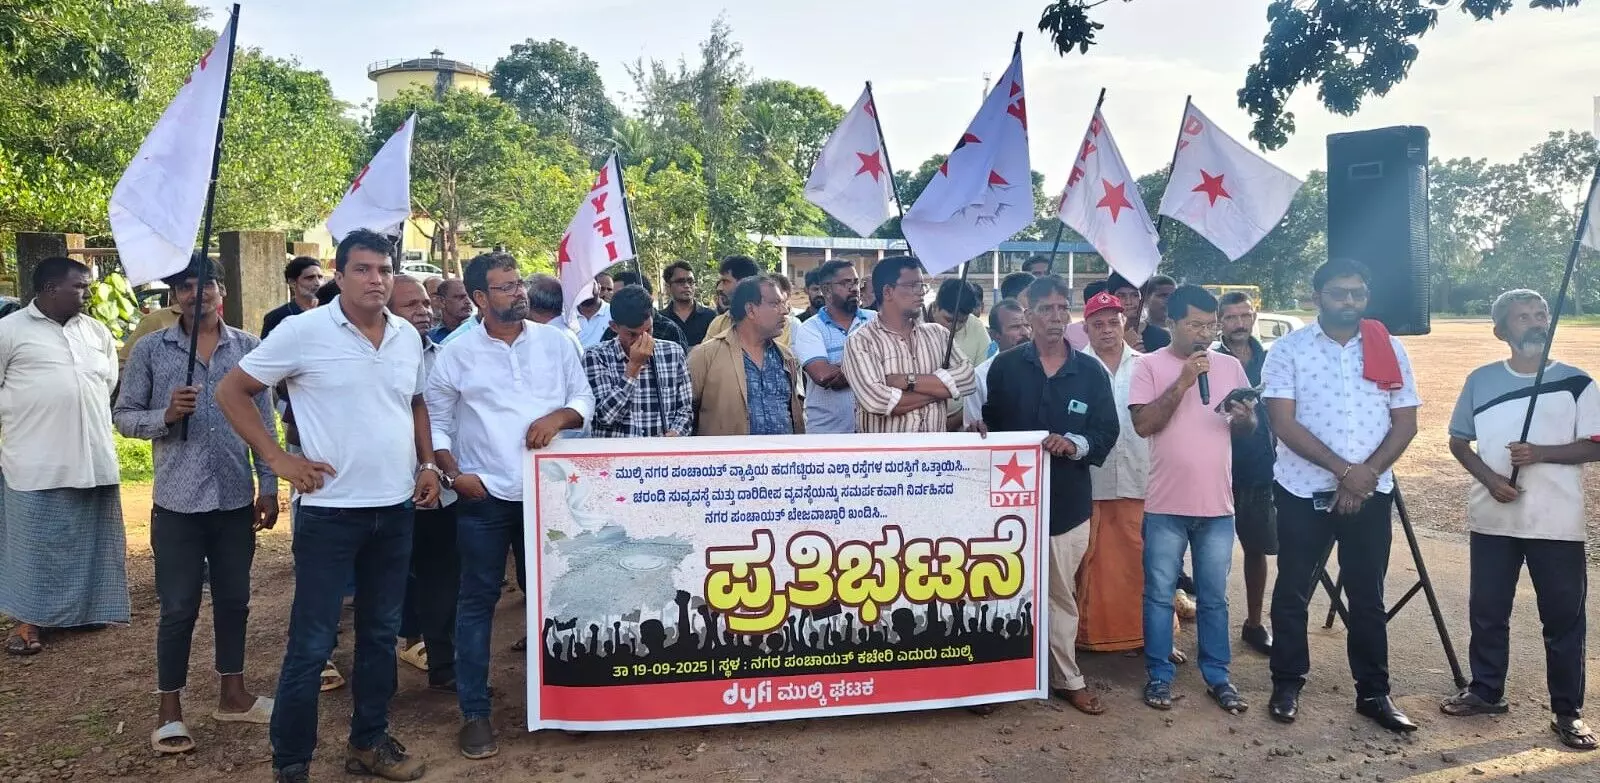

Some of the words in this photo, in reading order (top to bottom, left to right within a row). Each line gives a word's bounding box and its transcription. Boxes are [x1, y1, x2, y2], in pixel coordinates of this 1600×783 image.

[615, 466, 644, 484] ಮುಲ್ಕಿ
[645, 465, 669, 479] ನಗರ
[671, 463, 727, 478] ಪಂಚಾಯತ್
[729, 463, 769, 482] ವ್ಯಾಪ್ತಿಯ
[771, 461, 825, 480] ಹದಗೆಟ್ಟಿರುವ
[827, 462, 852, 479] ಎಲ್ಲಾ
[852, 459, 883, 479] ರಸ್ತೆಗಳ
[884, 459, 920, 478] ದುರಸ್ತಿಗೆ
[632, 489, 666, 504] ಚರಂಡಿ
[711, 487, 736, 506] ಮತ್ತು
[737, 485, 782, 501] ದಾರಿದೀಪ
[784, 484, 840, 506] ವ್ಯವಸ್ಥೆಯನ್ನು
[841, 483, 904, 498] ಸಮರ್ಪಕವಾಗಿ
[906, 482, 954, 496] ನಿರ್ವಹಿಸದ
[991, 492, 1035, 506] DYFI
[704, 510, 728, 524] ನಗರ
[730, 508, 786, 523] ಪಂಚಾಯತ್
[787, 507, 846, 525] ಬೇಜವಾಬ್ದಾರಿ
[848, 506, 888, 520] ಖಂಡಿಸಿ...
[704, 515, 1027, 635] ಪ್ರತಿಭಟನೆ
[612, 665, 629, 677] ತಾ
[632, 660, 708, 676] 19-09-2025
[719, 656, 741, 678] ಸ್ಥಳ
[750, 655, 781, 669] ನಗರ
[784, 651, 855, 668] ಪಂಚಾಯತ್
[857, 648, 894, 664] ಕಚೇರಿ
[896, 647, 938, 661] ಎದುರು
[940, 643, 975, 662] ಮುಲ್ಕಿ
[722, 680, 772, 710] dyfi
[777, 681, 828, 706] ಮುಲ್ಕಿ
[829, 677, 875, 702] ಘಟಕ
